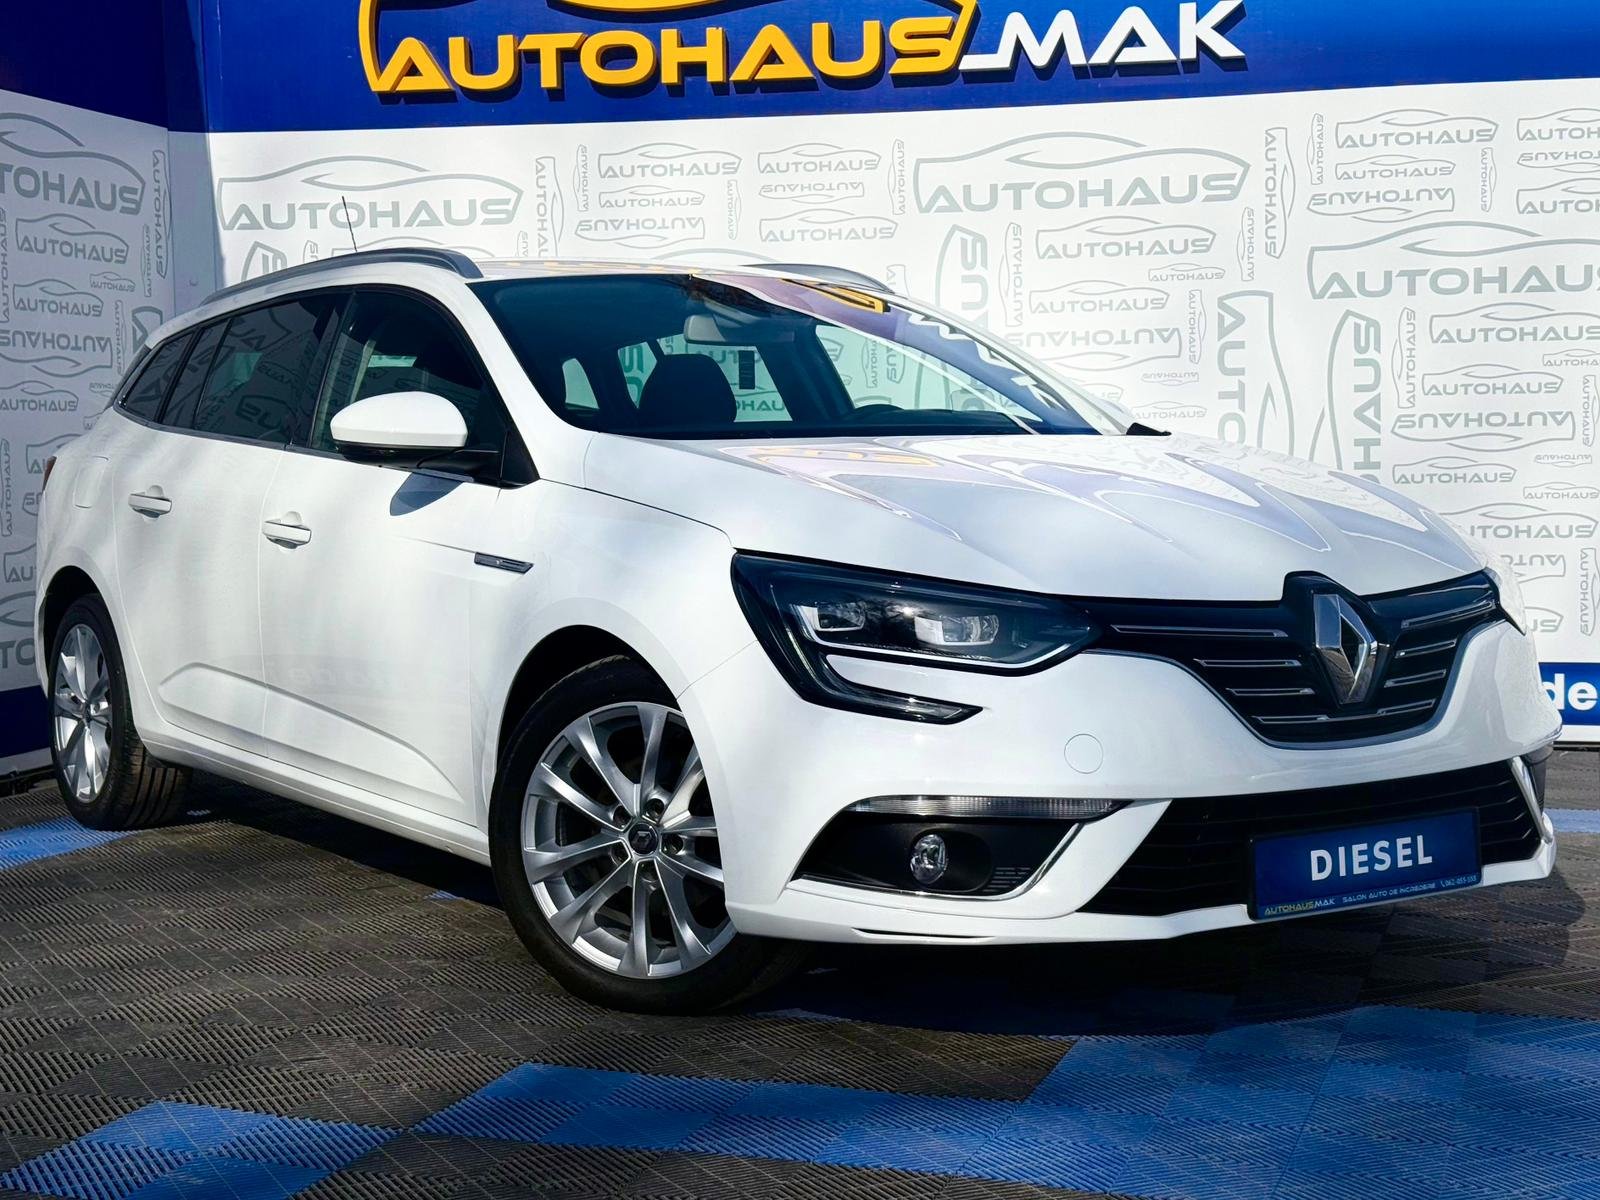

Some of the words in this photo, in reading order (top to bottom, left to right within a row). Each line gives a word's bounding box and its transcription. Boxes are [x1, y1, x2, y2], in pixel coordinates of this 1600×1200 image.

[371, 17, 966, 93] AUTOHAUS
[957, 0, 1246, 71] MAK
[1316, 113, 1324, 185] AUTOHAUS
[1338, 127, 1496, 149] AUTOHAUS
[603, 161, 738, 179] AUTOHAUS
[762, 158, 877, 174] AUTOHAUS
[1338, 166, 1454, 181] AUTOHAUS
[580, 145, 588, 212] AUTOHAUS
[762, 181, 861, 193] AUTOHAUS
[897, 140, 905, 216] AUTOHAUS
[1480, 148, 1488, 212] AUTOHAUS
[602, 195, 704, 209] AUTOHAUS
[921, 172, 1242, 214] AUTOHAUS
[1264, 128, 1278, 259] AUTOHAUS
[1311, 187, 1452, 207] AUTOHAUS
[152, 150, 166, 280] AUTOHAUS
[224, 197, 514, 231] AUTOHAUS
[579, 217, 701, 232] AUTOHAUS
[764, 225, 896, 243] AUTOHAUS
[1247, 207, 1255, 281] AUTOHAUS
[19, 235, 127, 265] AUTOHAUS
[1040, 237, 1213, 260] AUTOHAUS
[90, 280, 136, 293] AUTOHAUS
[1013, 224, 1023, 327] AUTOHAUS
[1149, 271, 1225, 282] AUTOHAUS
[1314, 263, 1600, 300] AUTOHAU
[16, 296, 103, 318] AUTOHAUS
[1033, 297, 1167, 314] AUTOHAUS
[1007, 327, 1179, 348] AUTOHAUS
[1188, 291, 1197, 365] AUTOHAUS
[0, 329, 112, 353] AUTOHAUS
[1406, 310, 1416, 408] AUTOHAUS
[1424, 381, 1562, 396] AUTOHAUS
[0, 398, 78, 412] AUTOHAUS
[1132, 408, 1207, 420] AUTOHAUS
[1582, 376, 1591, 447] AUTOHAUS
[1397, 410, 1572, 430] AUTOHAUS
[1535, 453, 1592, 462] AUTOHAUS
[5, 438, 13, 536] AUTOHAUS
[1395, 470, 1515, 485] AUTOHAUS
[1524, 491, 1600, 500] AUTOHAUS
[1580, 549, 1589, 636] AUTOHAUS
[1310, 834, 1433, 882] DIESEL
[1342, 892, 1367, 904] SALON
[1368, 889, 1388, 899] AUTO
